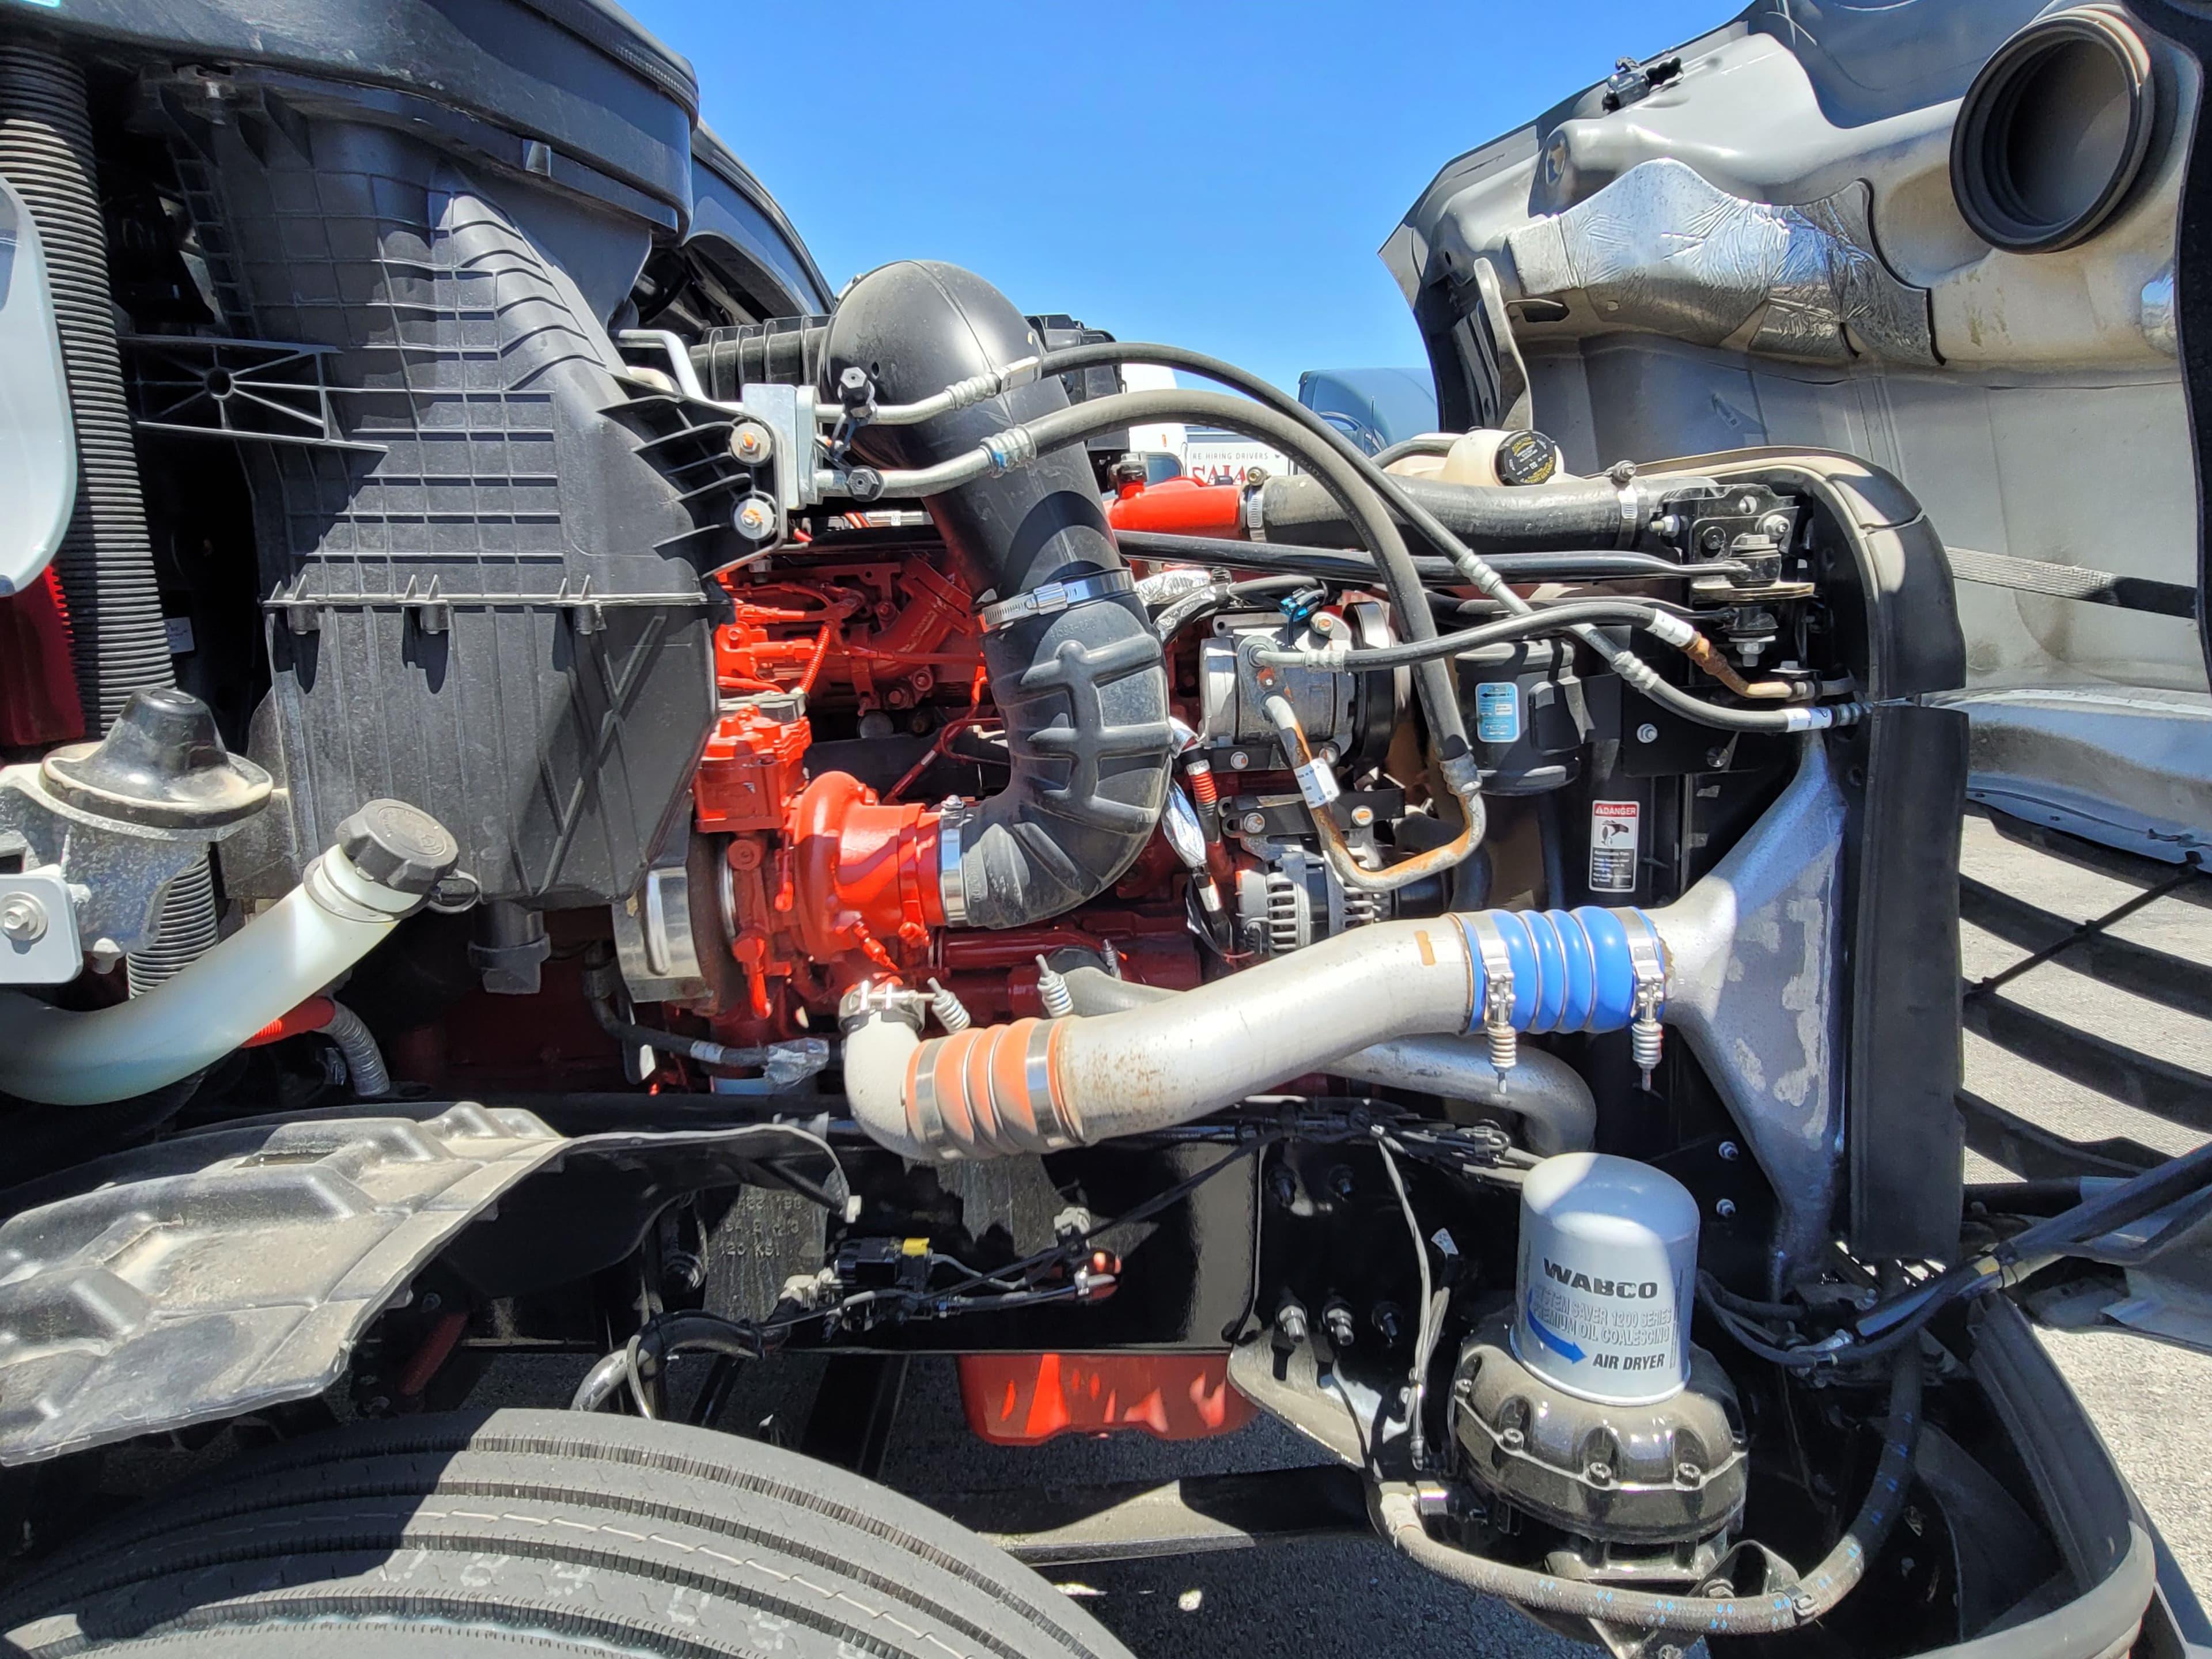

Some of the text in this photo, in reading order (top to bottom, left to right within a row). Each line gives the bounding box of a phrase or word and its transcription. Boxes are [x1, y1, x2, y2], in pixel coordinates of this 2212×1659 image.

[1192, 464, 1247, 485] SAIA
[1603, 806, 1636, 815] DANGER
[1543, 1257, 1658, 1299] WABCO
[1533, 1302, 1670, 1346] PREMIUM OIL COALESCING
[1571, 1299, 1608, 1325] SAVER
[1612, 1310, 1639, 1328] 1200
[1641, 1308, 1672, 1328] SERIES
[1593, 1353, 1665, 1370] AIR DRYER
